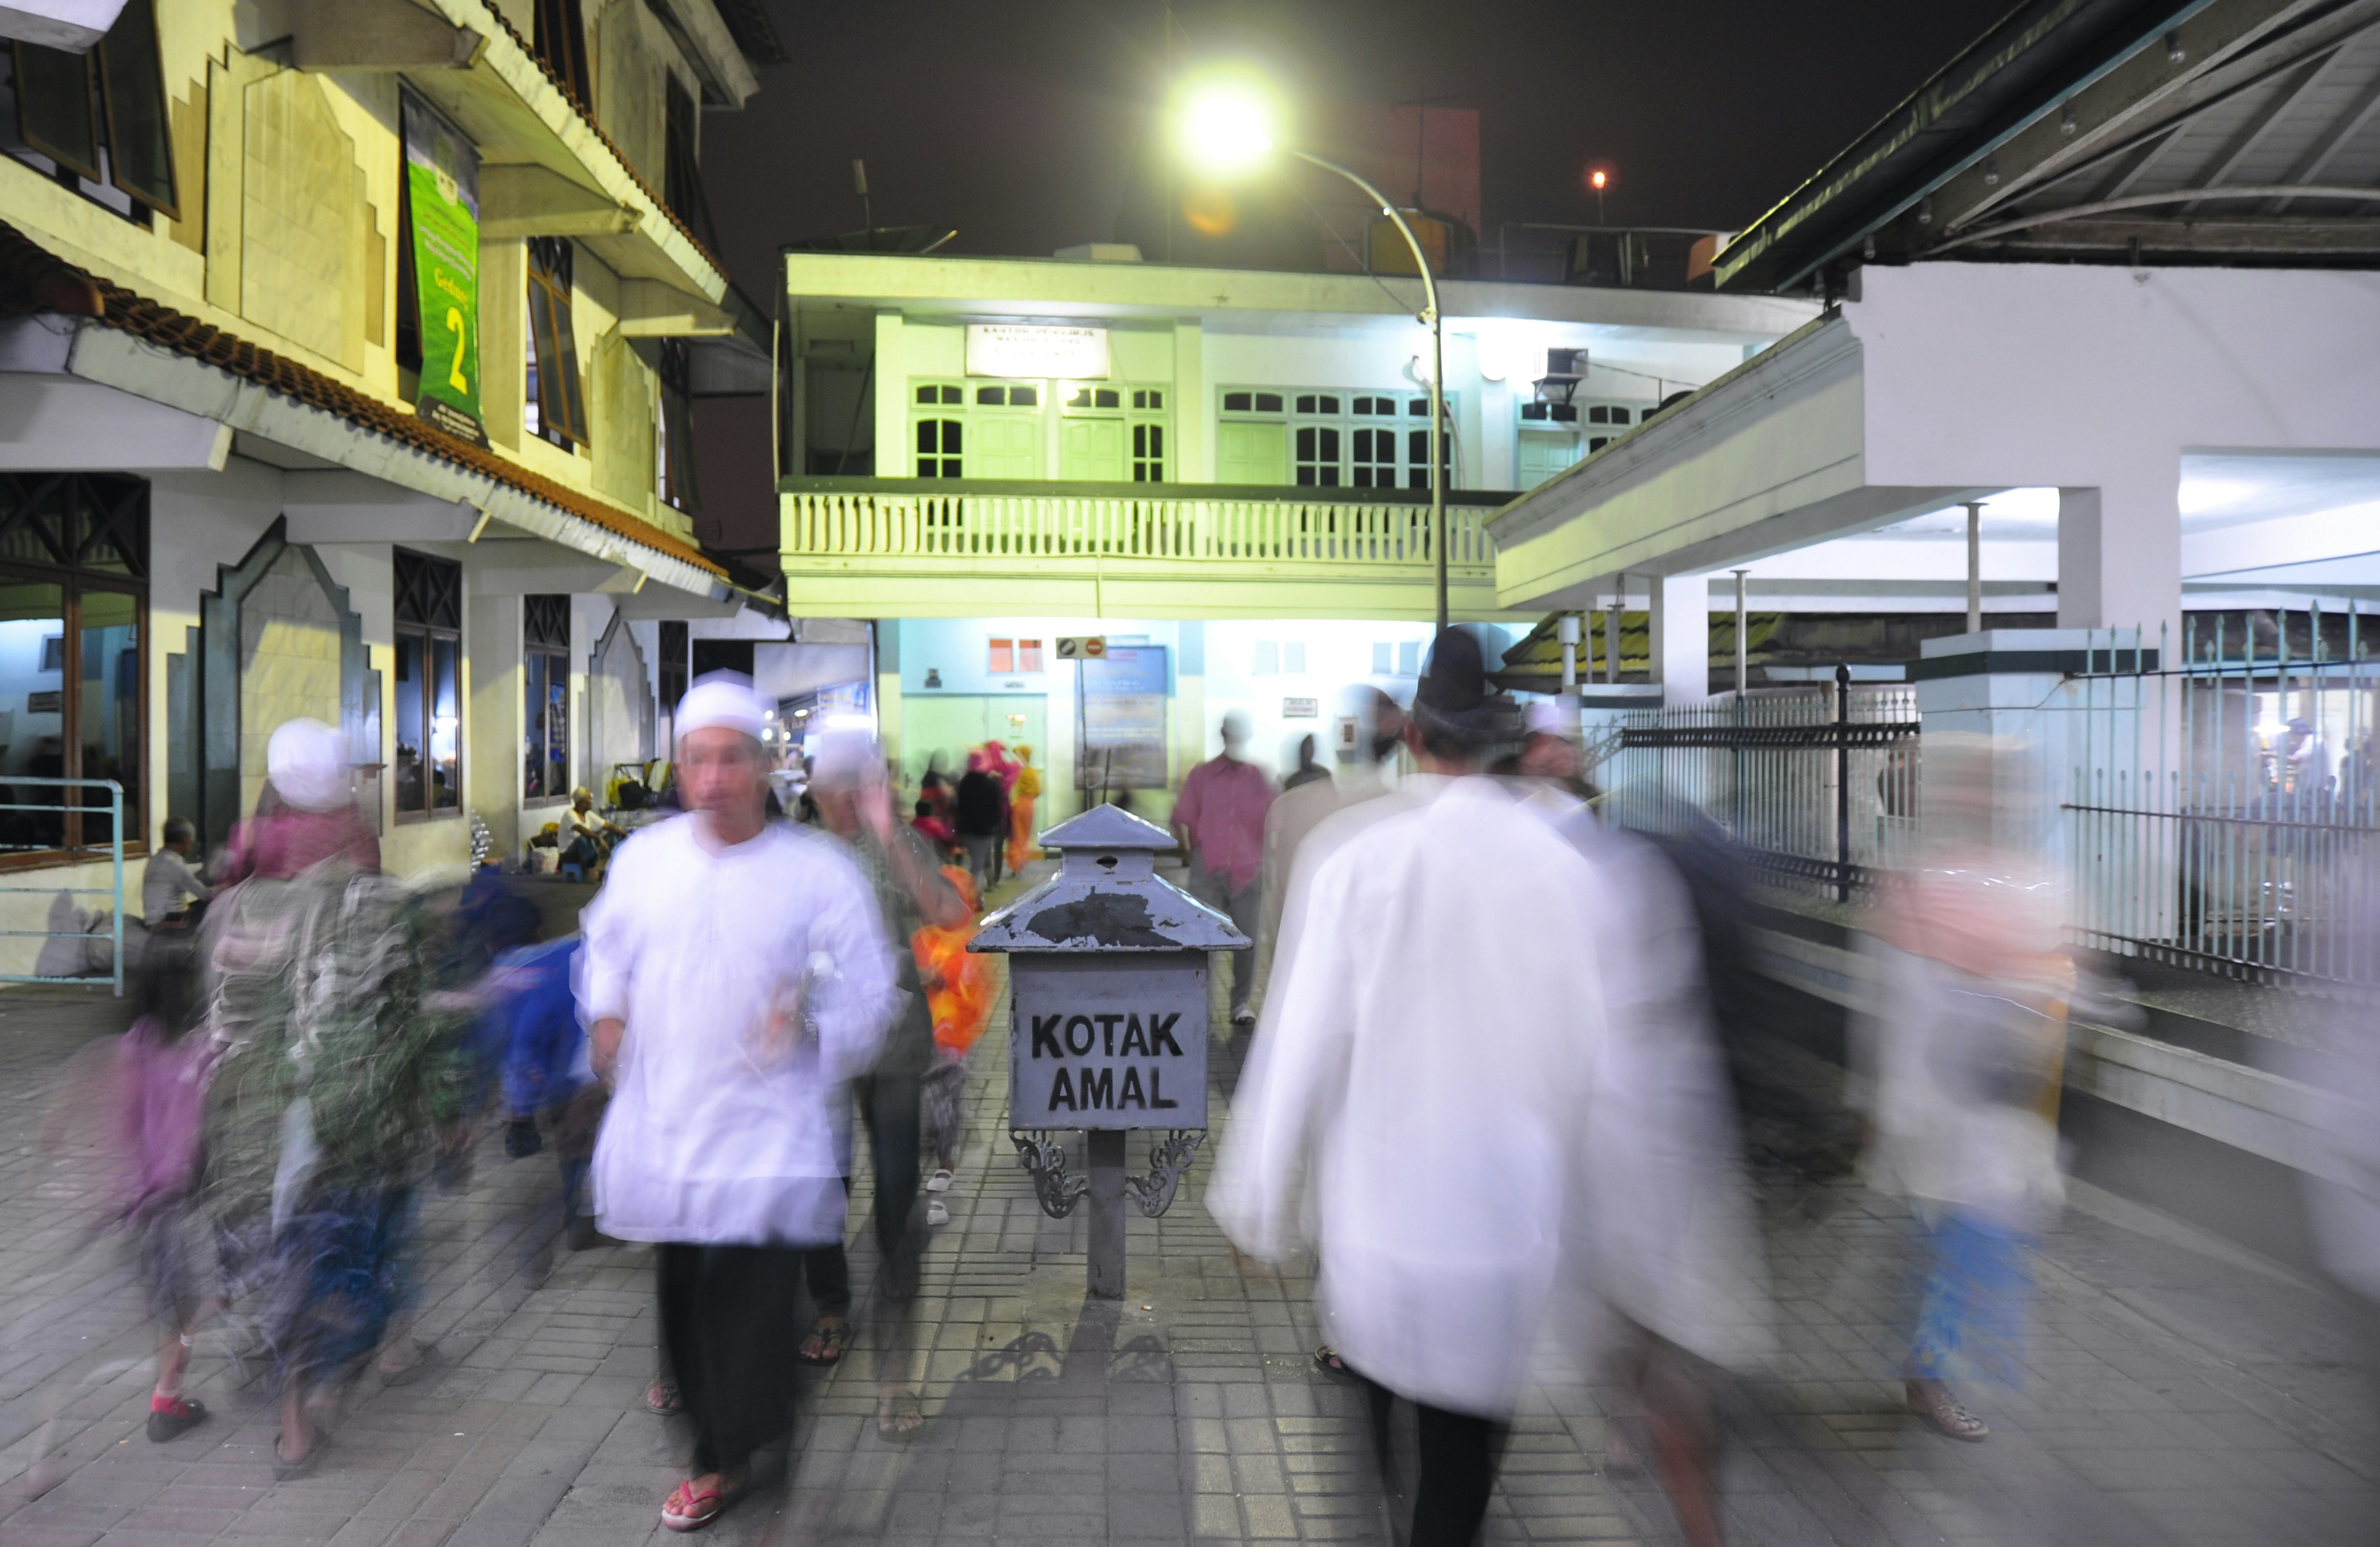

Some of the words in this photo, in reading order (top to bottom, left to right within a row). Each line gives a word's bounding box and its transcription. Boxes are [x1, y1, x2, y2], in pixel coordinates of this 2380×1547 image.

[447, 305, 468, 395] 2
[1032, 1013, 1184, 1059] KOTAK
[1048, 1066, 1178, 1111] AMAL
